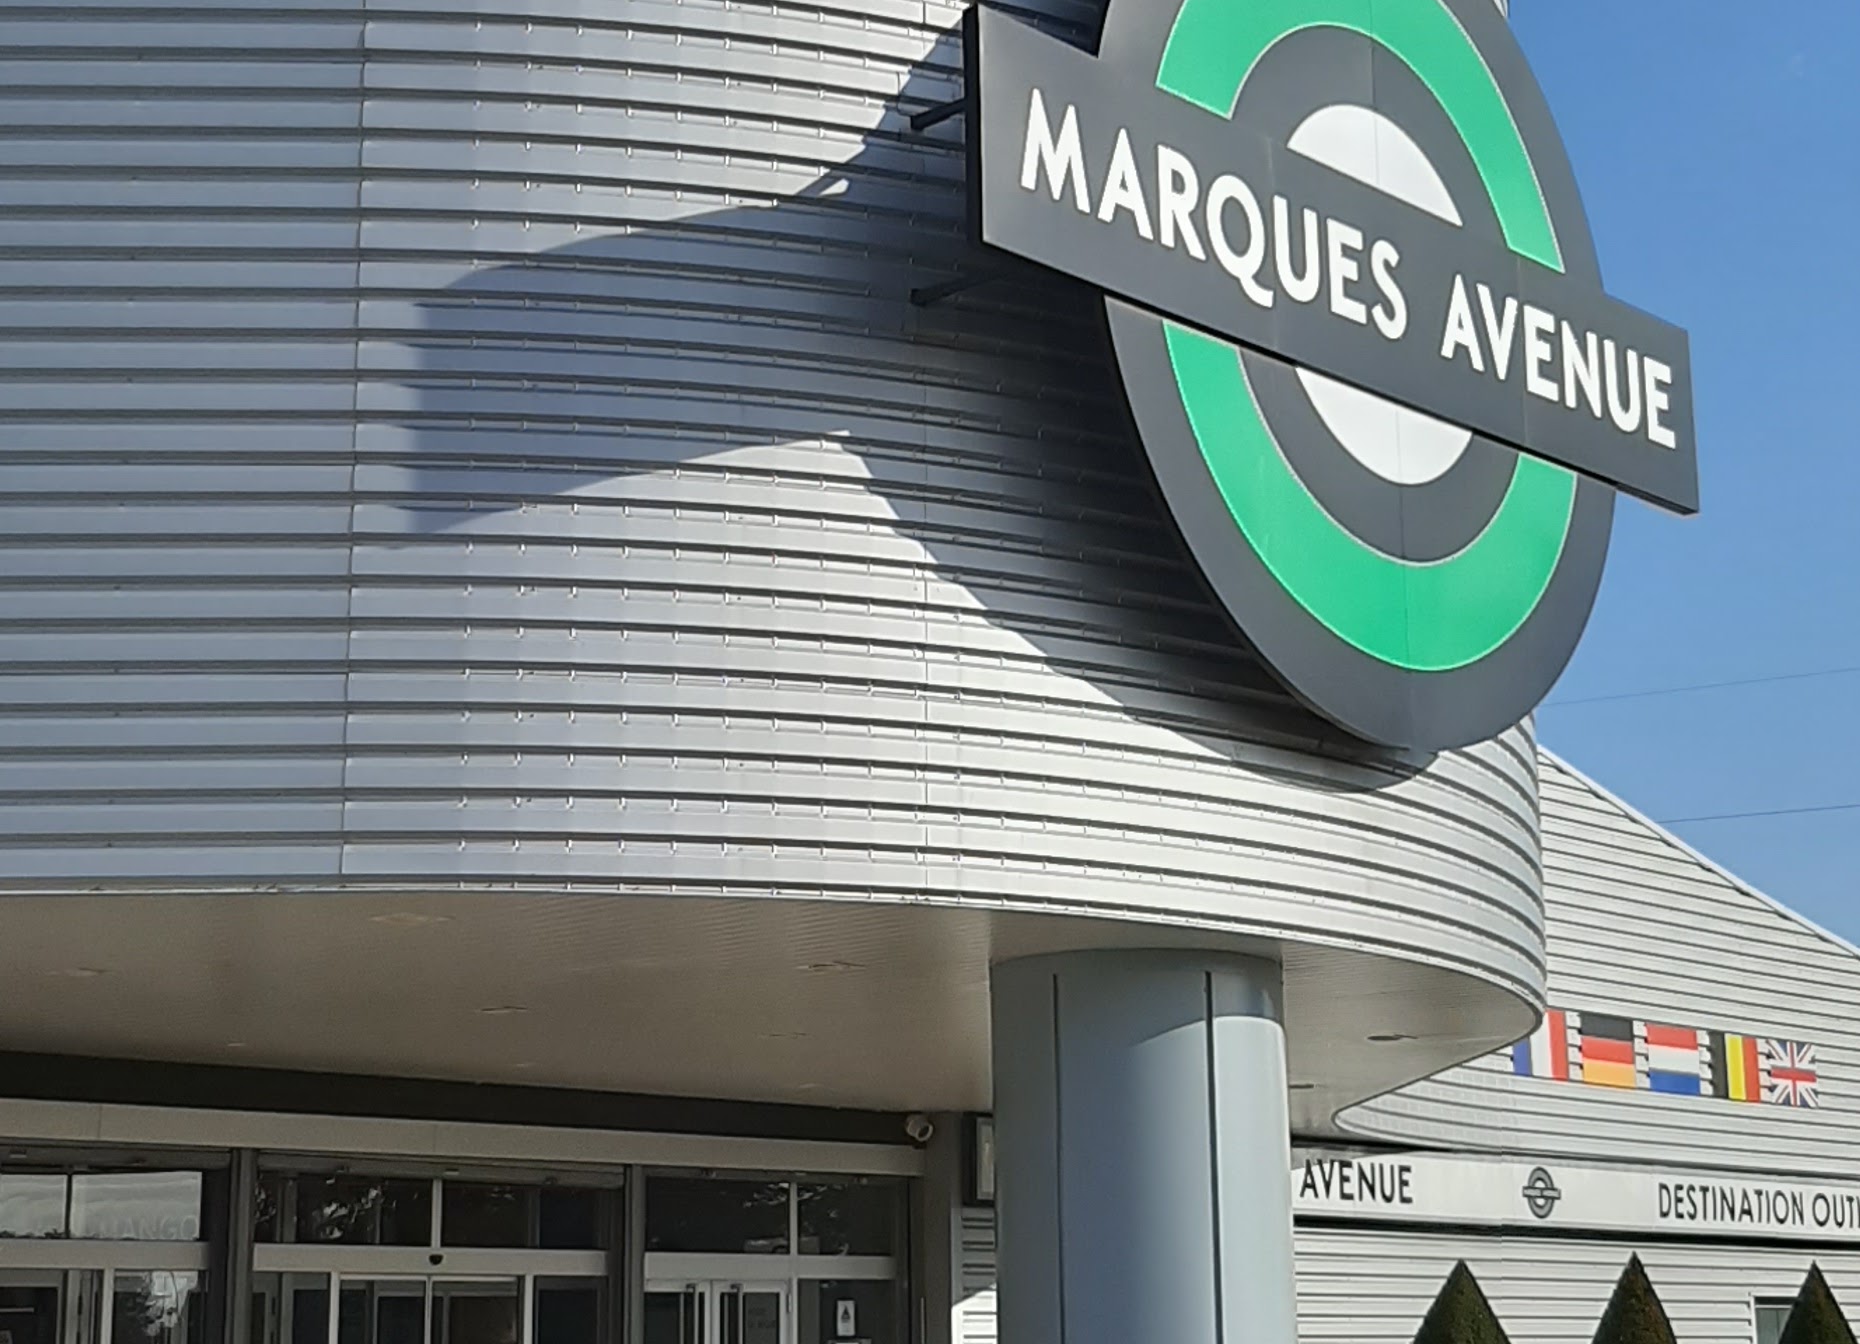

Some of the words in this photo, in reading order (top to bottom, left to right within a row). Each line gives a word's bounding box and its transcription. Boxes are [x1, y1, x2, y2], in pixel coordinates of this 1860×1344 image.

[1020, 87, 1408, 340] MARQUES
[1440, 273, 1676, 449] AVENUE
[1299, 1158, 1413, 1204] AVENUE
[1658, 1182, 1804, 1225] DESTINATION
